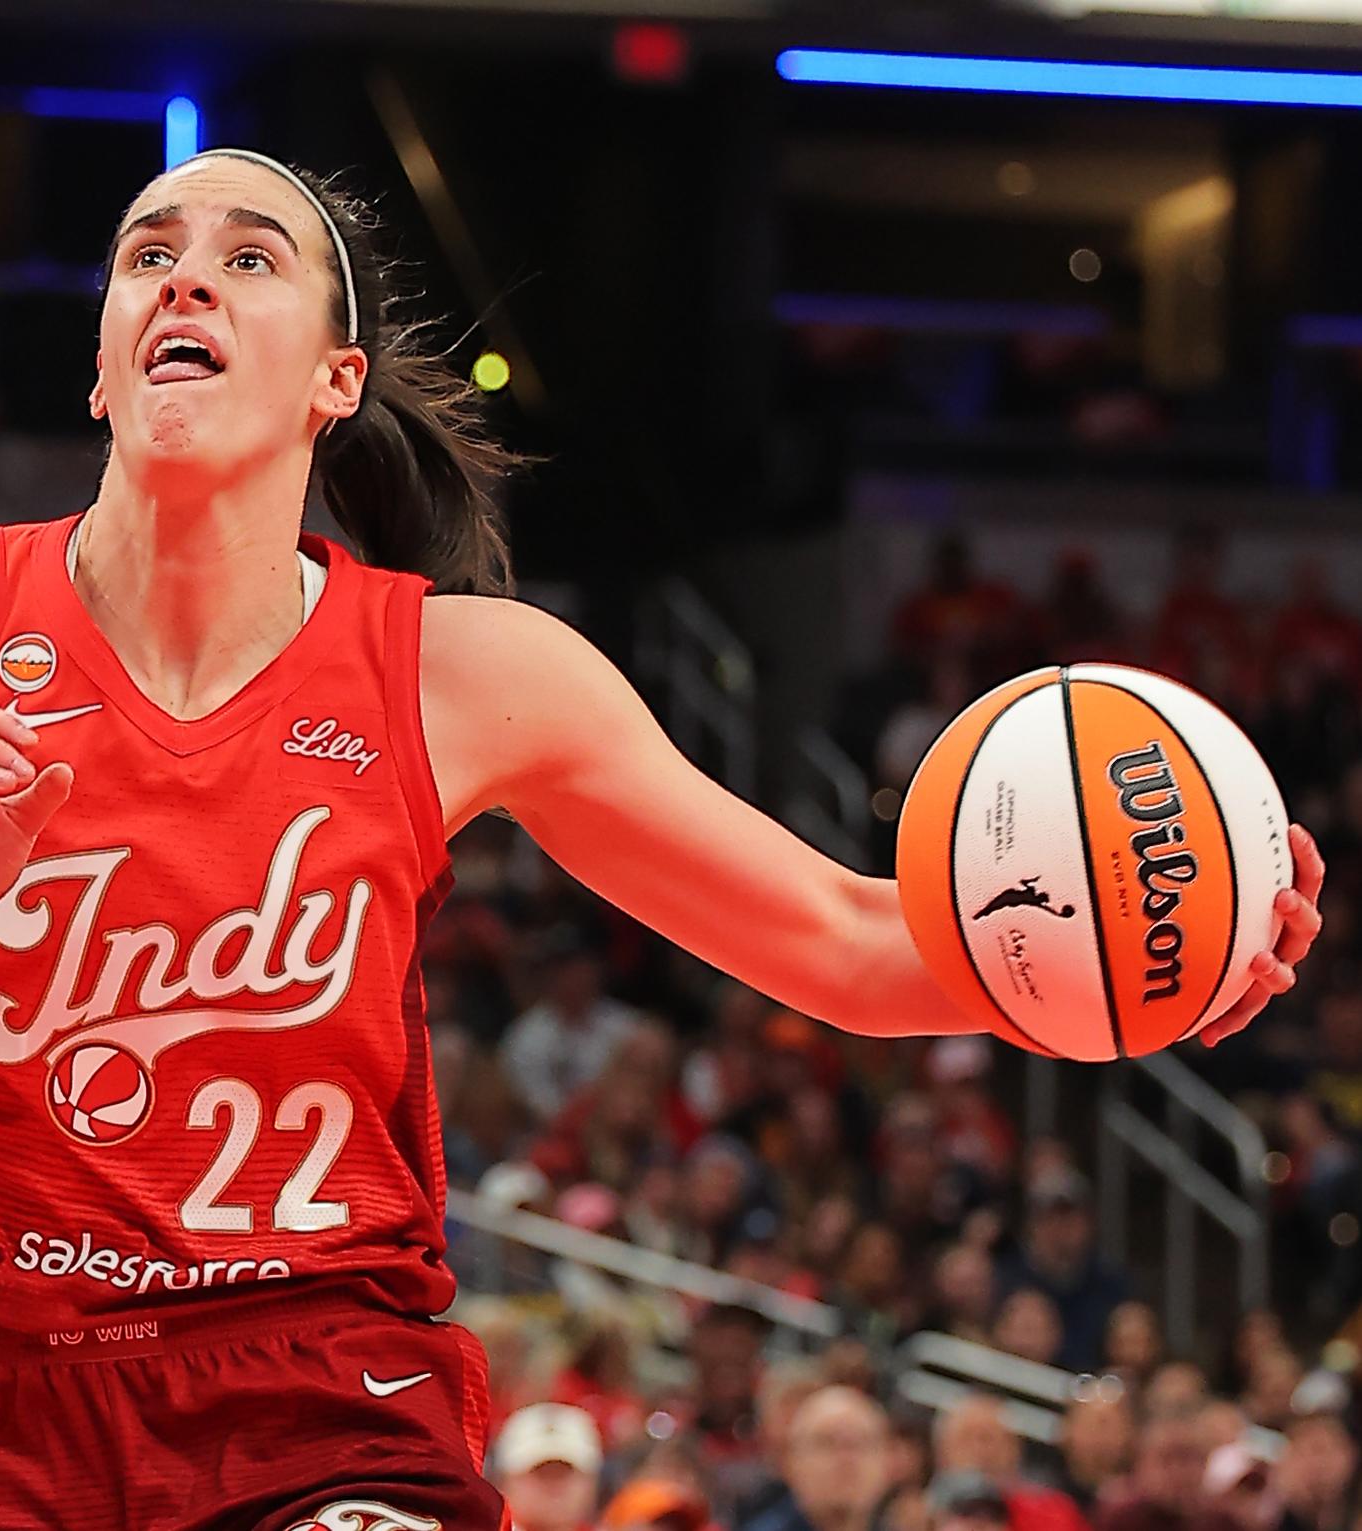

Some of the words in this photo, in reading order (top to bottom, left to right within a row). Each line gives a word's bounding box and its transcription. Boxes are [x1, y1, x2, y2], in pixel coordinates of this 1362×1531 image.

[282, 717, 380, 775] Lilly
[1106, 739, 1198, 1006] Wilson
[178, 1076, 354, 1233] 22
[95, 1320, 158, 1342] WIN
